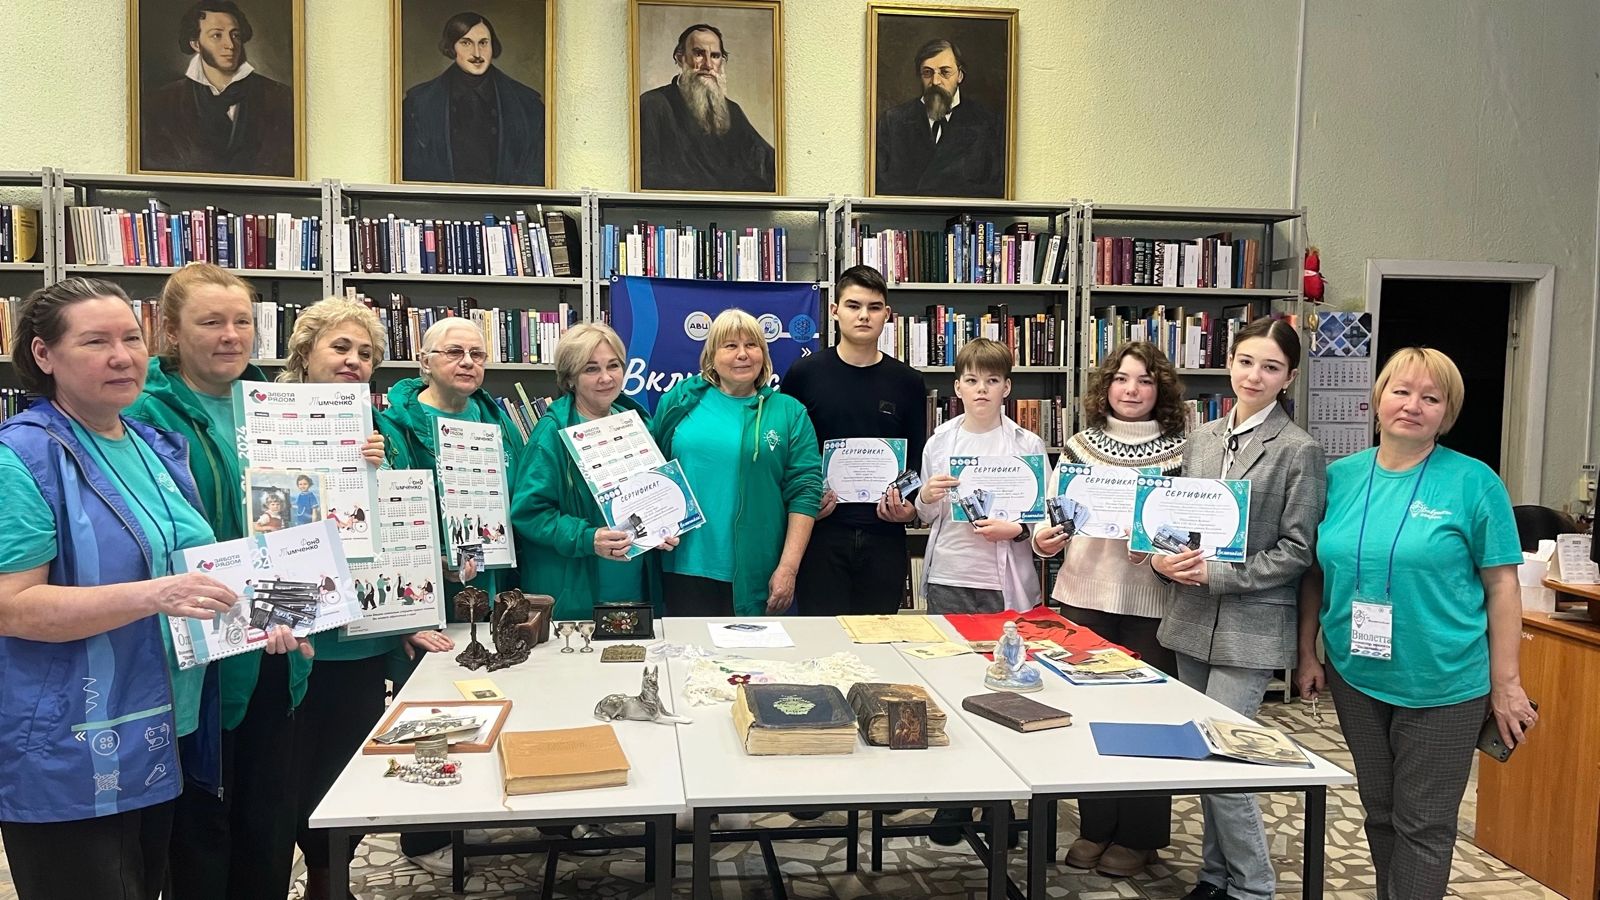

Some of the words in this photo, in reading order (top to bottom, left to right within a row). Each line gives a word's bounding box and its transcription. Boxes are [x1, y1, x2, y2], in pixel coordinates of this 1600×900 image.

[1085, 477, 1136, 486] СЕРТИФИКАТ
[620, 480, 661, 503] СЕРТИФИКАТ
[1165, 490, 1223, 500] СЕРТИФИКАТ
[1352, 630, 1391, 644] Виолетта
